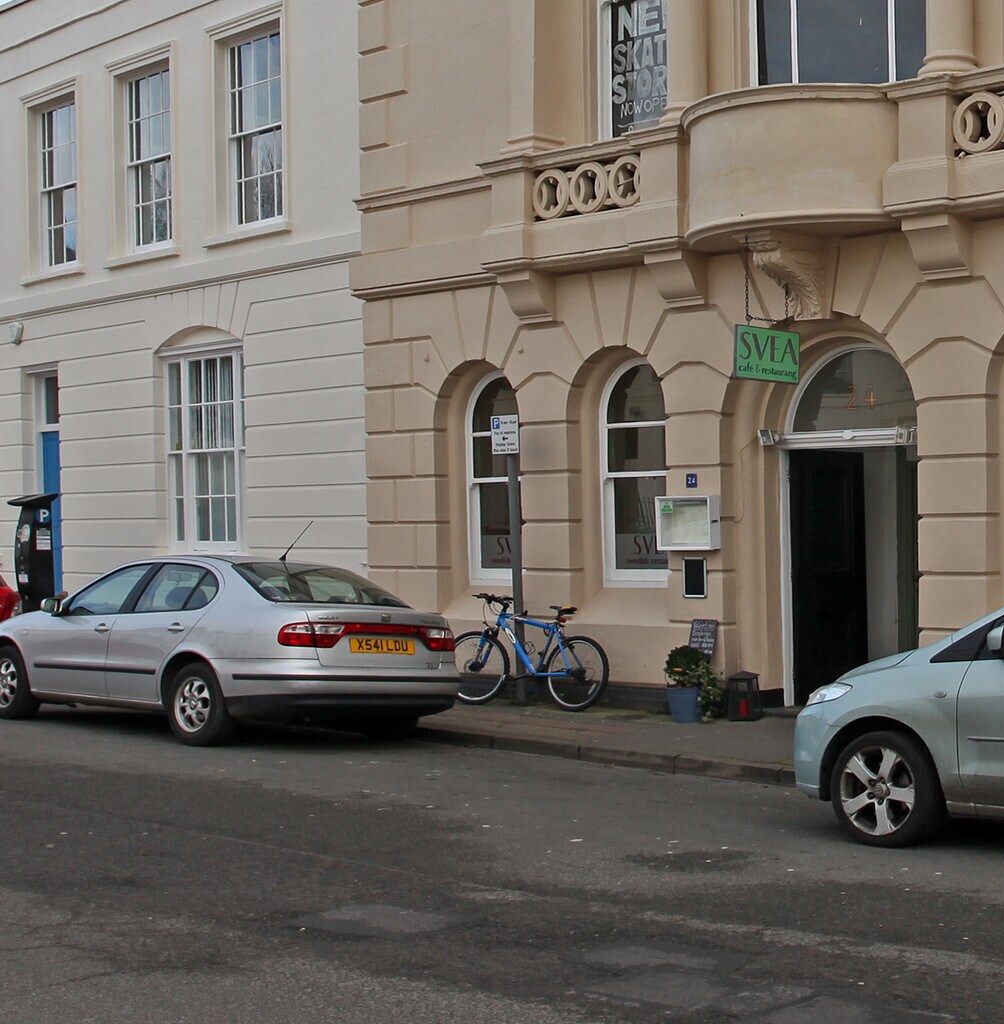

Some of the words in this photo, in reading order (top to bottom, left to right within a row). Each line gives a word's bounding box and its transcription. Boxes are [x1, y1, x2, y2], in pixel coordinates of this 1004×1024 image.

[739, 331, 798, 365] SVEA
[761, 366, 797, 381] restaurang
[846, 383, 878, 410] 24
[687, 477, 696, 485] 24
[357, 639, 384, 652] X541
[386, 640, 408, 652] LDU
